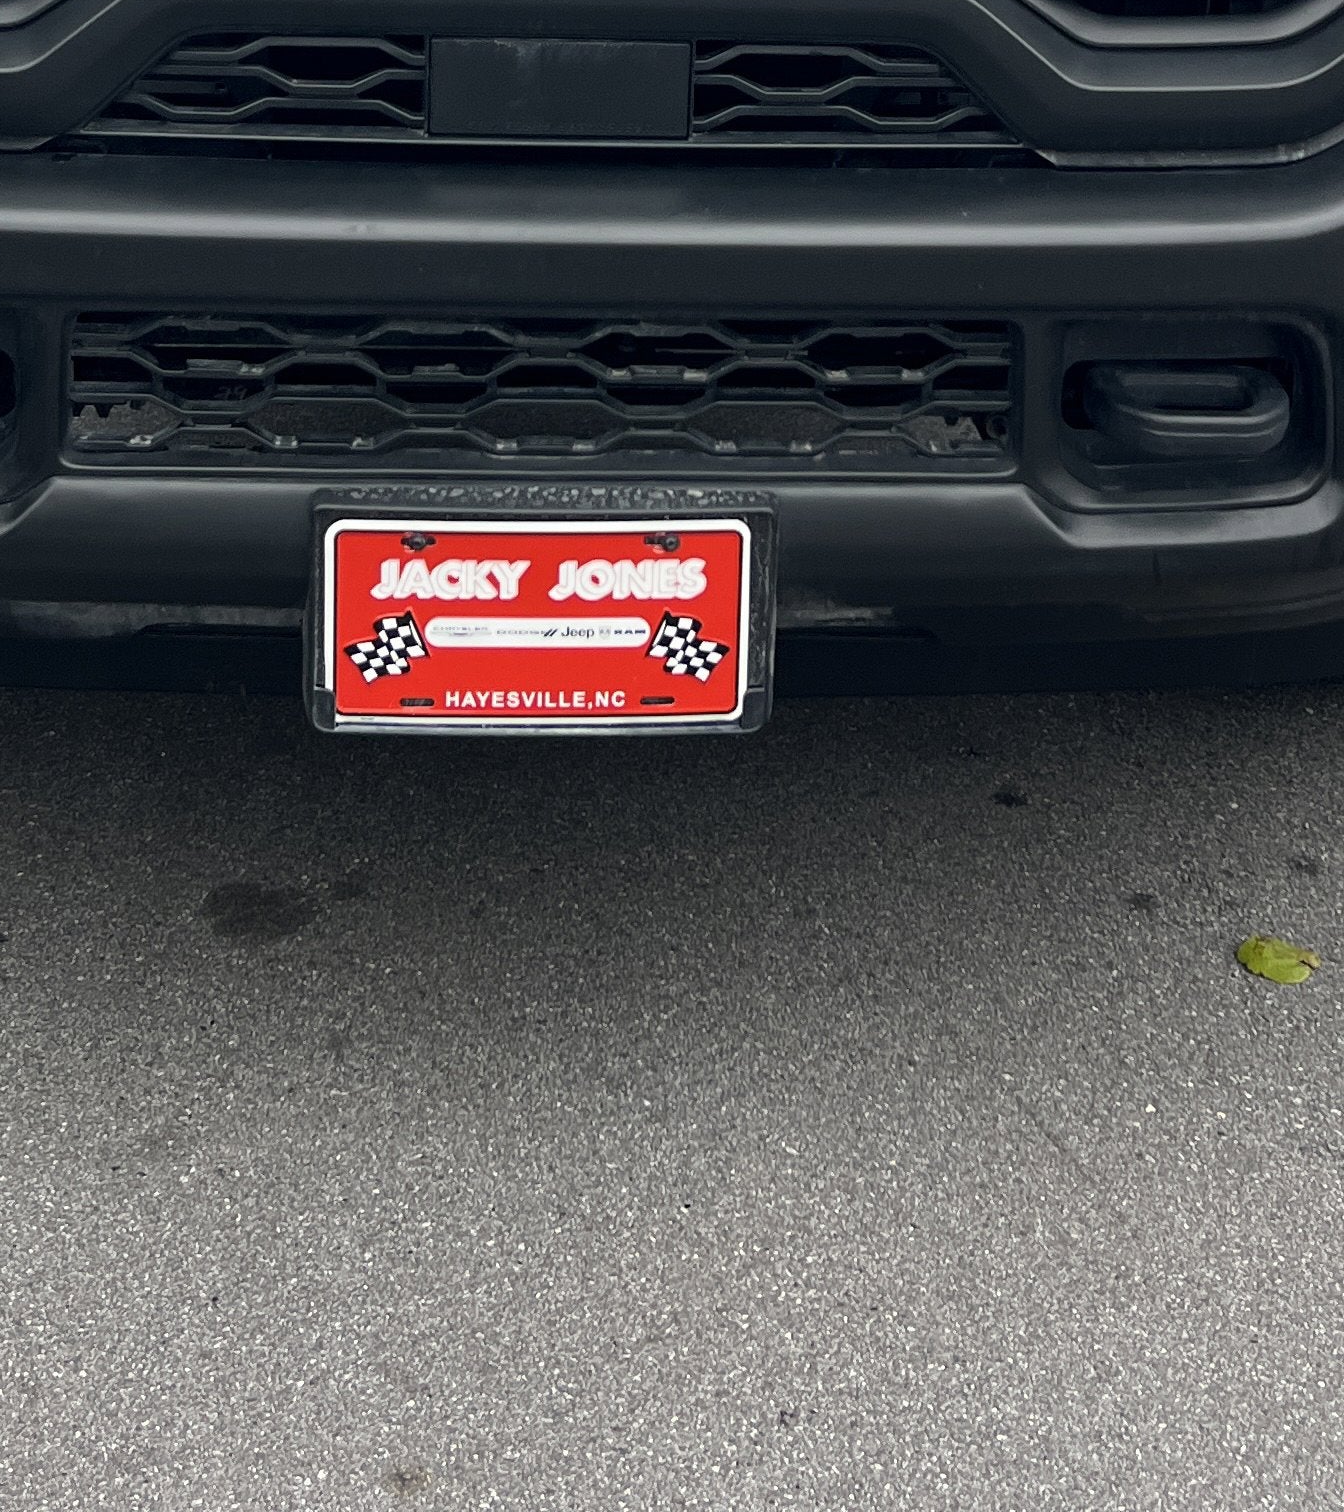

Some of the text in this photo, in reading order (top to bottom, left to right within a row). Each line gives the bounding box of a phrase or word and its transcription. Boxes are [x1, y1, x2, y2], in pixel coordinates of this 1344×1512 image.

[370, 558, 707, 600] JACKY JONES
[561, 626, 595, 639] Jeep
